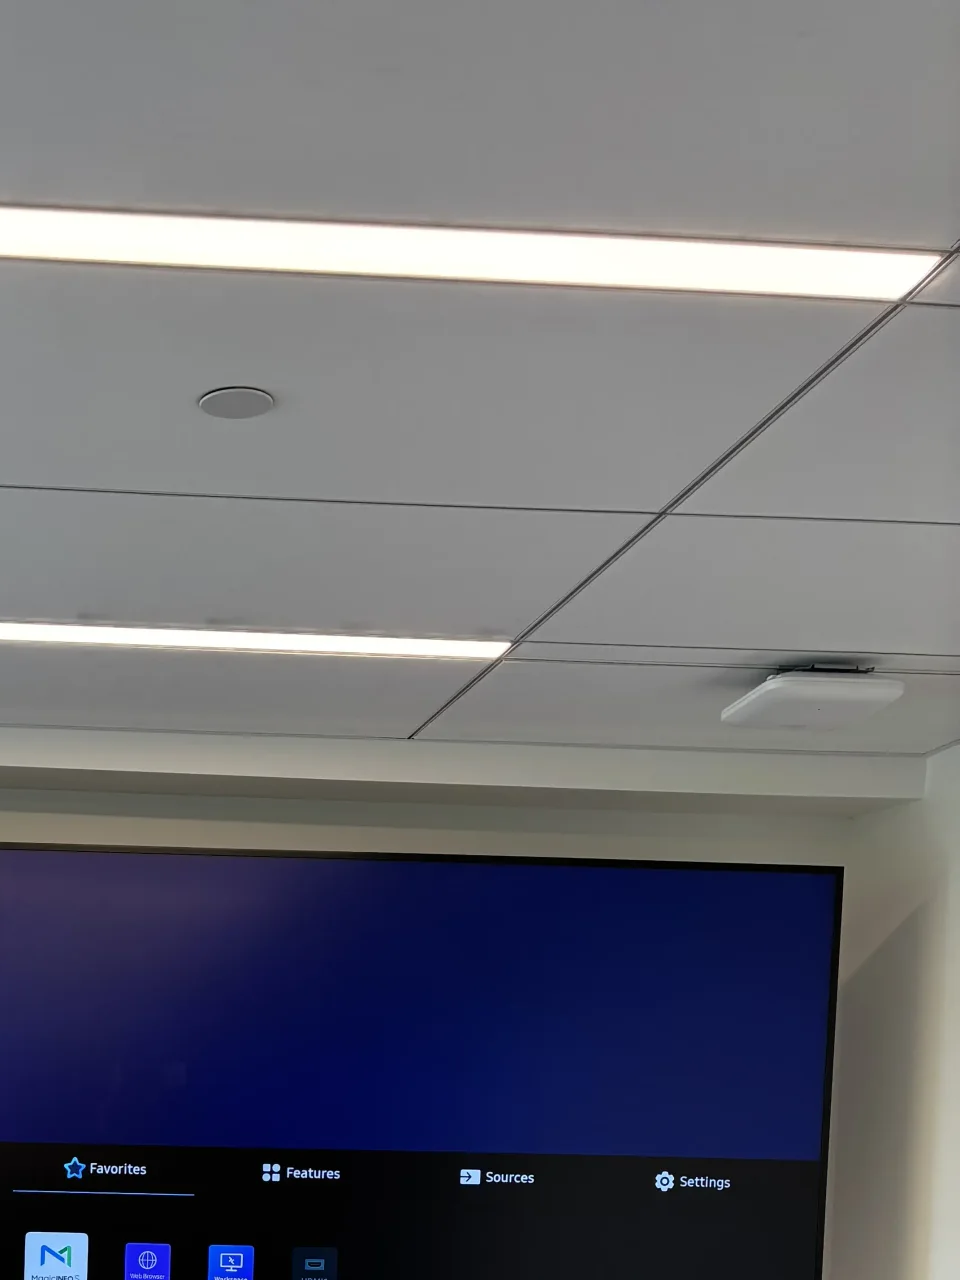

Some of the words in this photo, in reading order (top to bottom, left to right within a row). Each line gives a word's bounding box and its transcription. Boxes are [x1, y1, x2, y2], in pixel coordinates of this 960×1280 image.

[89, 1162, 147, 1176] Favorites
[286, 1167, 341, 1180] Features
[485, 1171, 535, 1184] Sources
[679, 1175, 731, 1191] Settings
